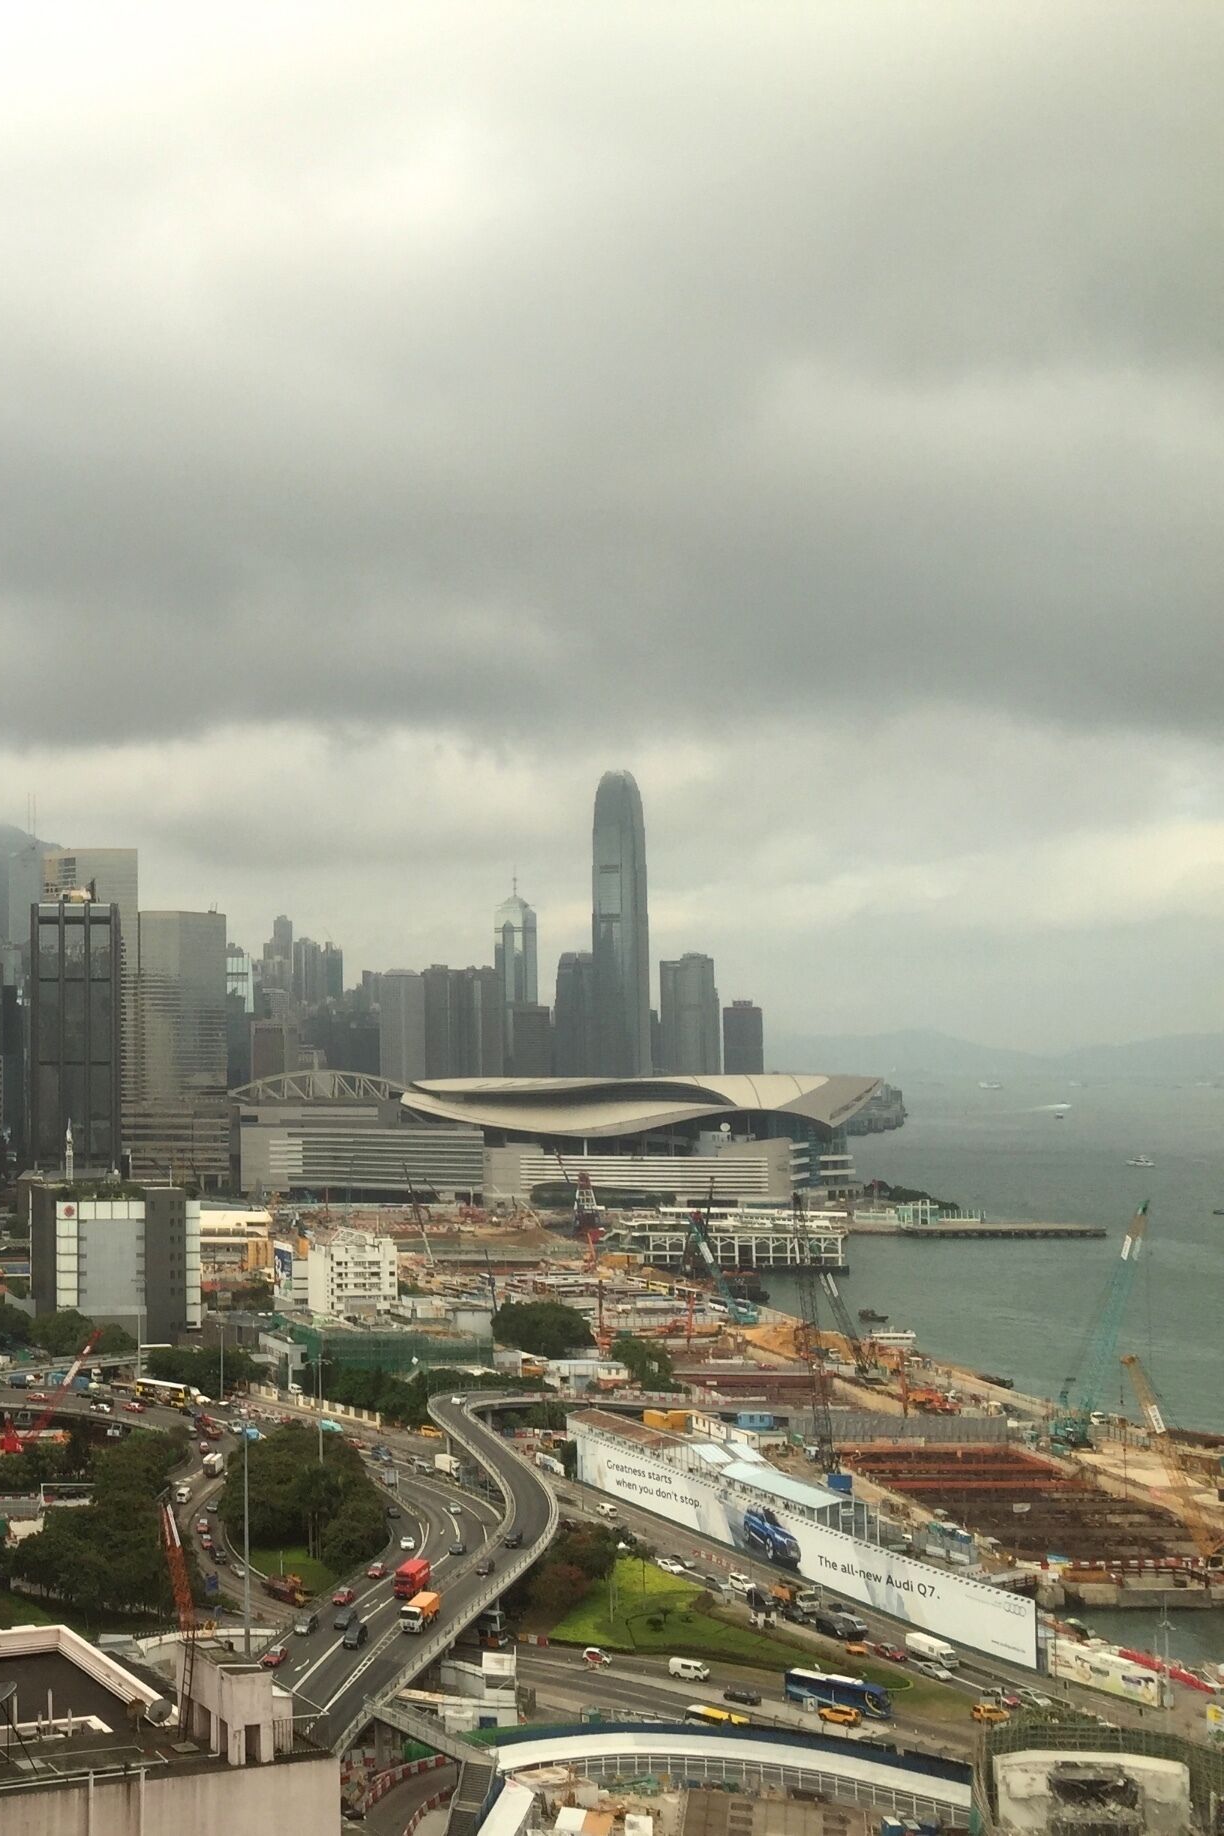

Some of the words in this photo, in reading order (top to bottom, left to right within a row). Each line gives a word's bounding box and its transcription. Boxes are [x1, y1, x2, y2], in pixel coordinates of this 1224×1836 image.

[606, 1459, 646, 1478] Greatness
[648, 1471, 672, 1485] starts
[616, 1479, 637, 1490] when
[639, 1485, 653, 1495] you
[656, 1488, 677, 1502] don't
[680, 1495, 702, 1509] stop.
[817, 1554, 838, 1571] The
[840, 1563, 882, 1583] all-new
[886, 1574, 913, 1592] Audi
[917, 1583, 941, 1599] Q7.
